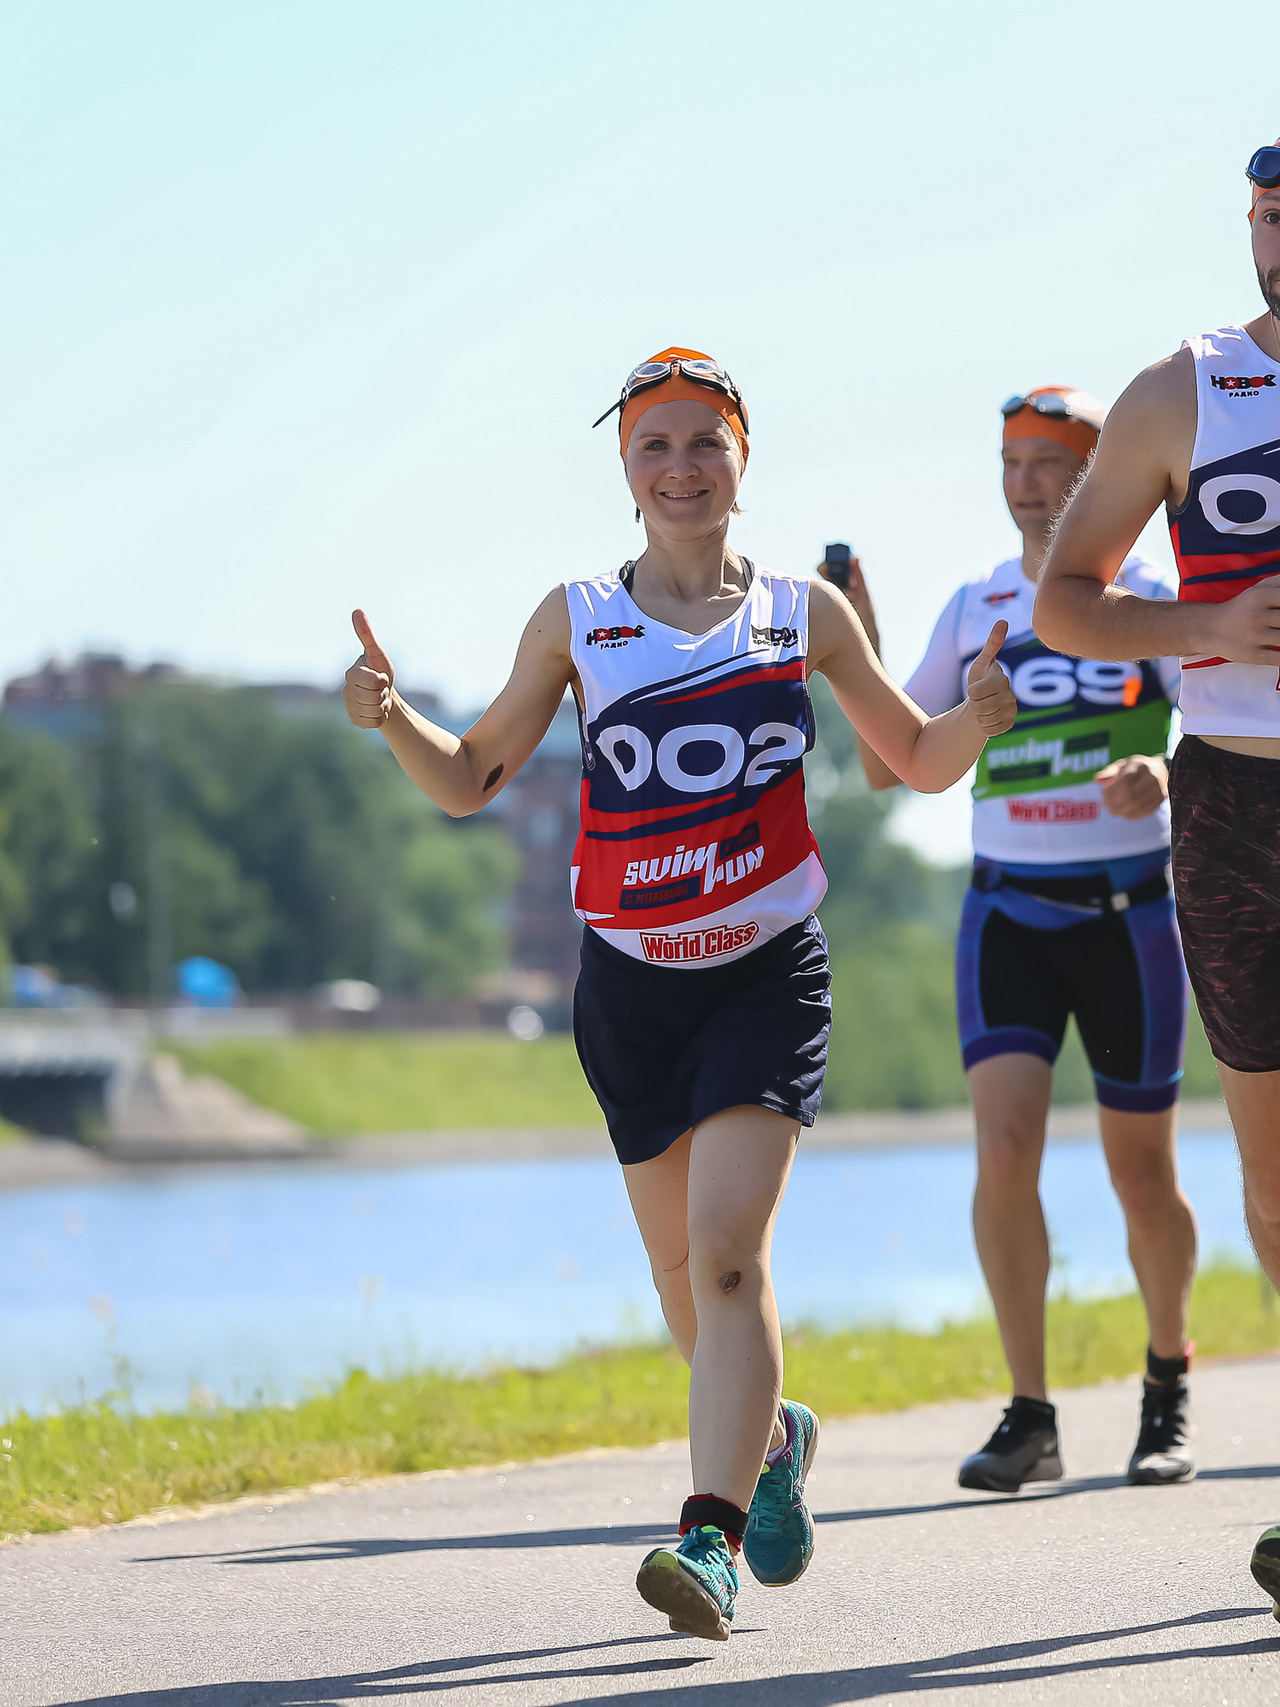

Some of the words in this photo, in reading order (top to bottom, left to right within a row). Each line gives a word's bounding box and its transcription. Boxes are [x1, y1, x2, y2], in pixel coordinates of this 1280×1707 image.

[595, 722, 806, 793] 002
[623, 842, 728, 885] swim
[636, 884, 688, 904] PETERSBURG
[644, 935, 703, 960] World
[704, 926, 757, 954] Class
